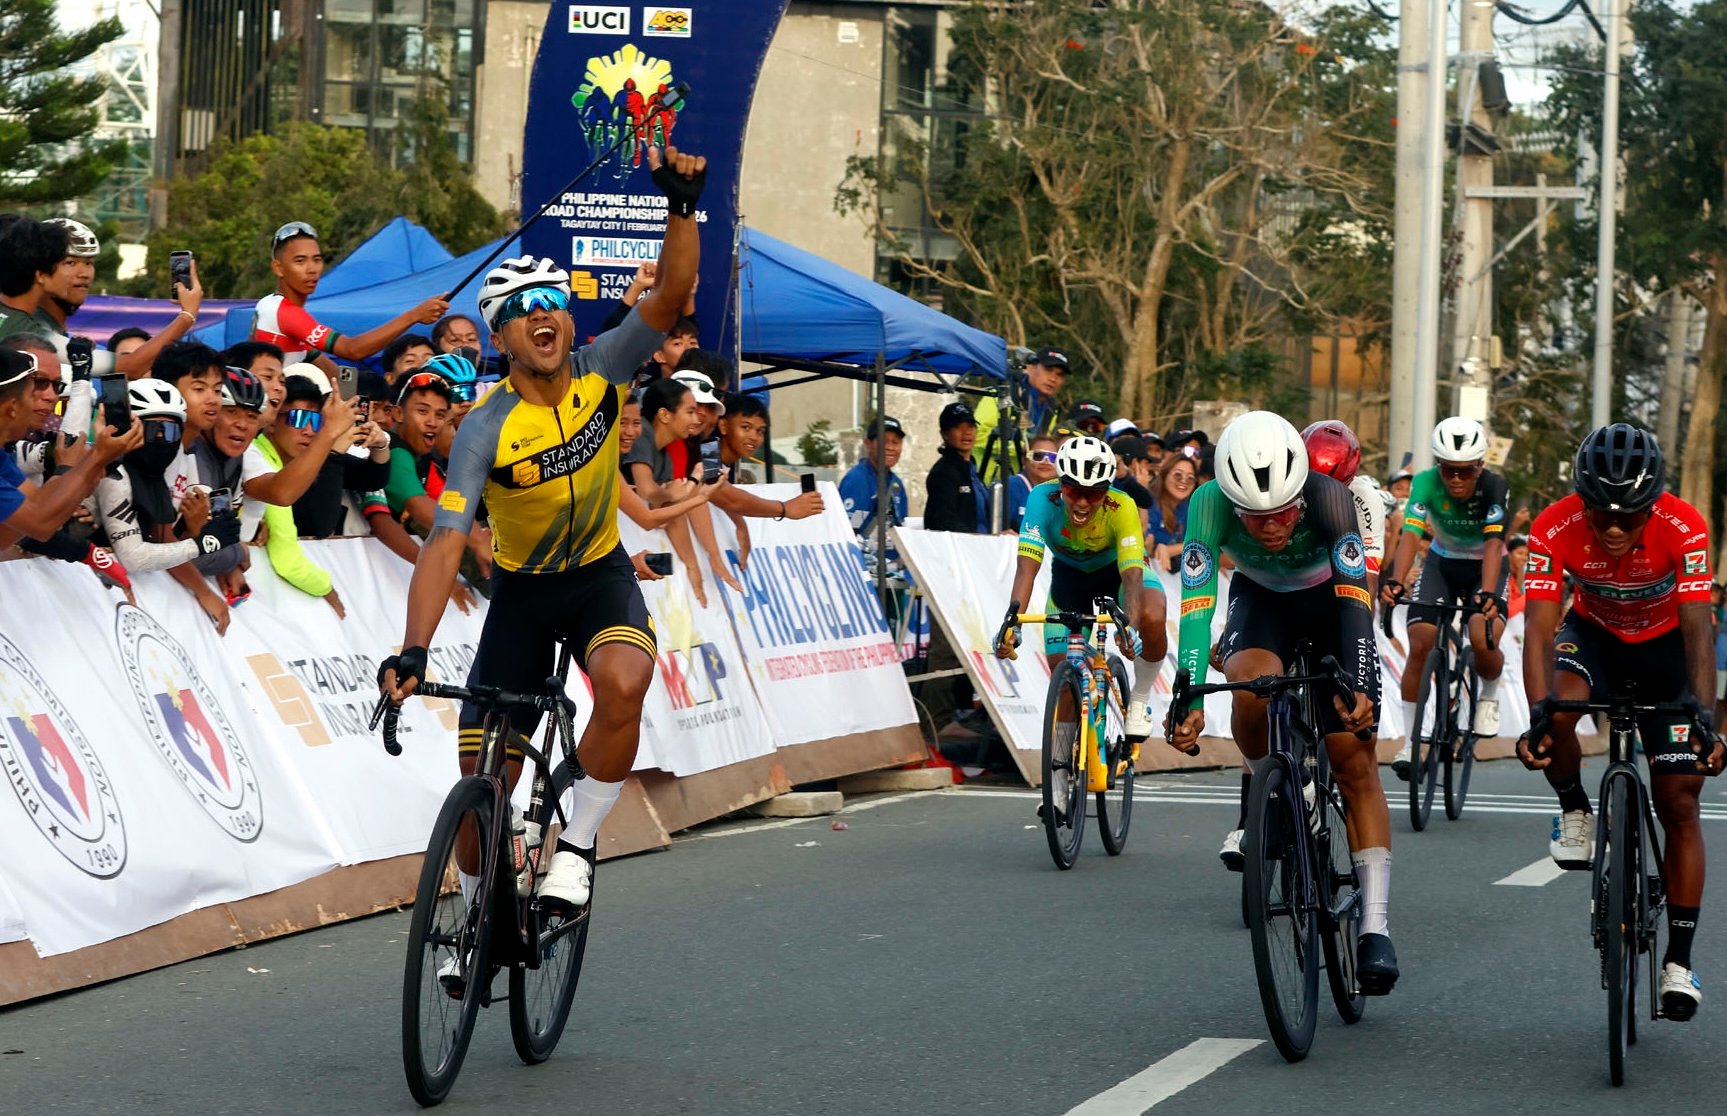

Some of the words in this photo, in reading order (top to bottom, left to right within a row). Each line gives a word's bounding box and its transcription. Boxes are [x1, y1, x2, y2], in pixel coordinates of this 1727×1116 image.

[583, 11, 624, 29] UCI
[561, 192, 626, 206] PHILIPPINE
[628, 195, 669, 208] NATION
[576, 205, 669, 221] CHAMPIONSHIP
[560, 219, 601, 230] TAGAYTAY
[602, 221, 622, 231] CITY
[591, 239, 663, 260] PHILCYCLIN
[601, 273, 637, 286] STAN
[306, 324, 329, 347] RCC
[542, 411, 604, 466] STANDARD
[544, 421, 608, 478] INSURANCE
[1355, 496, 1373, 533] RUDY
[1546, 511, 1584, 540] ELVE
[725, 540, 889, 649] PHILCYCLING
[1357, 638, 1367, 686] VICTORIA
[1655, 752, 1699, 763] Magene
[86, 843, 119, 869] 1990
